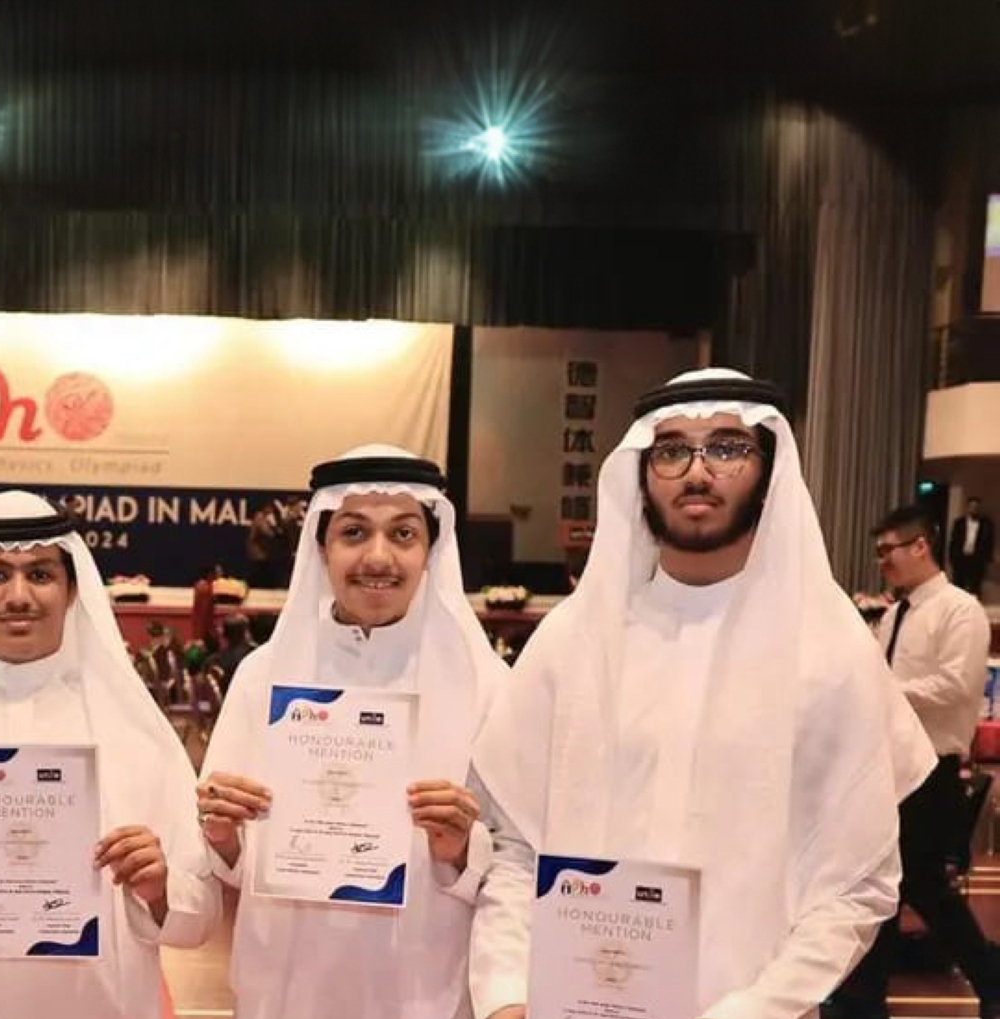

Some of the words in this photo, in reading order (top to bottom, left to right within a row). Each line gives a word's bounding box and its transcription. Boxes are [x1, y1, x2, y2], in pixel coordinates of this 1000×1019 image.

[70, 457, 162, 476] Olympiad
[148, 495, 183, 523] IN
[85, 530, 129, 548] 024
[288, 734, 396, 751] HONOURABLE
[308, 748, 375, 762] MENTION
[557, 908, 675, 931] HONOURABLE
[579, 923, 652, 941] MENTION
